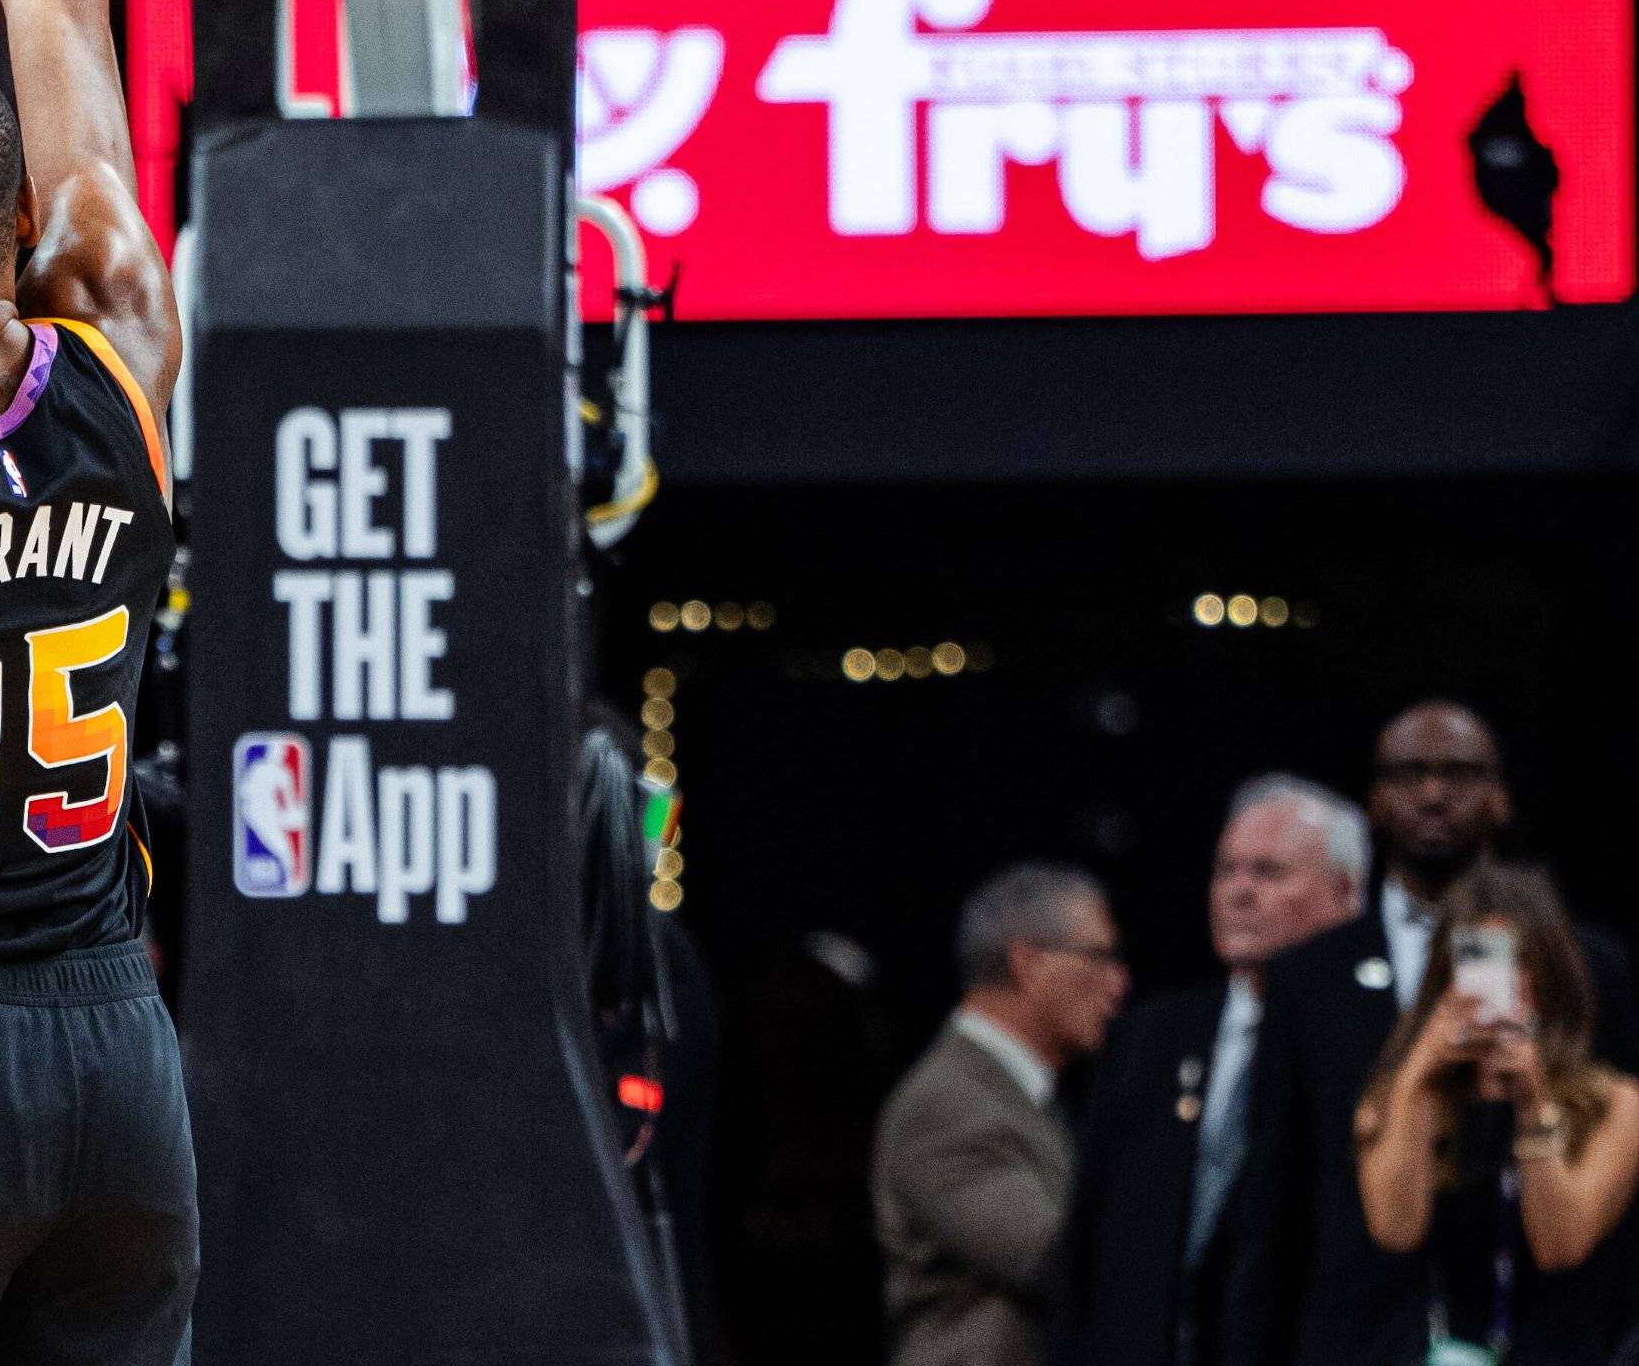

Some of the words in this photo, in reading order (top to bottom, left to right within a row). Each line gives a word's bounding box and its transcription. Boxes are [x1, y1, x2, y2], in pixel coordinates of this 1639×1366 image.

[274, 406, 453, 561] GET
[273, 570, 456, 721] THE
[315, 735, 499, 925] App
